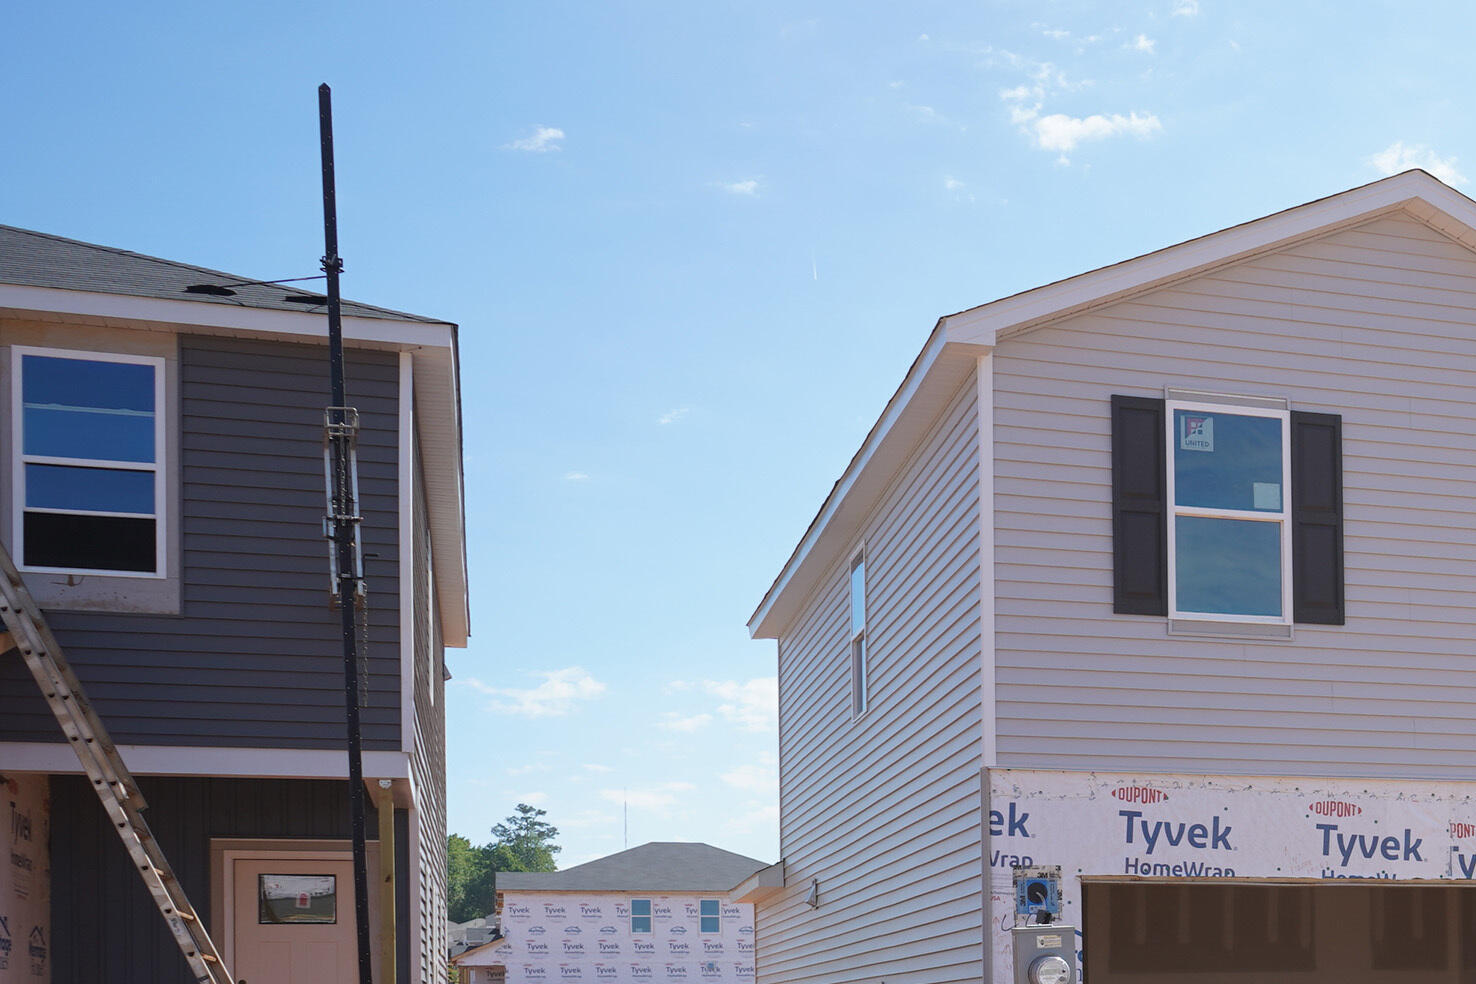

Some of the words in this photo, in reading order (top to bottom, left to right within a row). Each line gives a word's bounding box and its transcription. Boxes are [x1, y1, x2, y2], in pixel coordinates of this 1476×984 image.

[1118, 787, 1162, 804] DUPONT
[1315, 801, 1357, 817] DUPONT
[1119, 810, 1232, 854] Tyvek
[1450, 822, 1476, 838] PONT
[1316, 823, 1422, 866] Tyvek
[1125, 857, 1235, 877] HomeWrap
[631, 966, 652, 974] Tyvek
[666, 966, 687, 974] Tyvek
